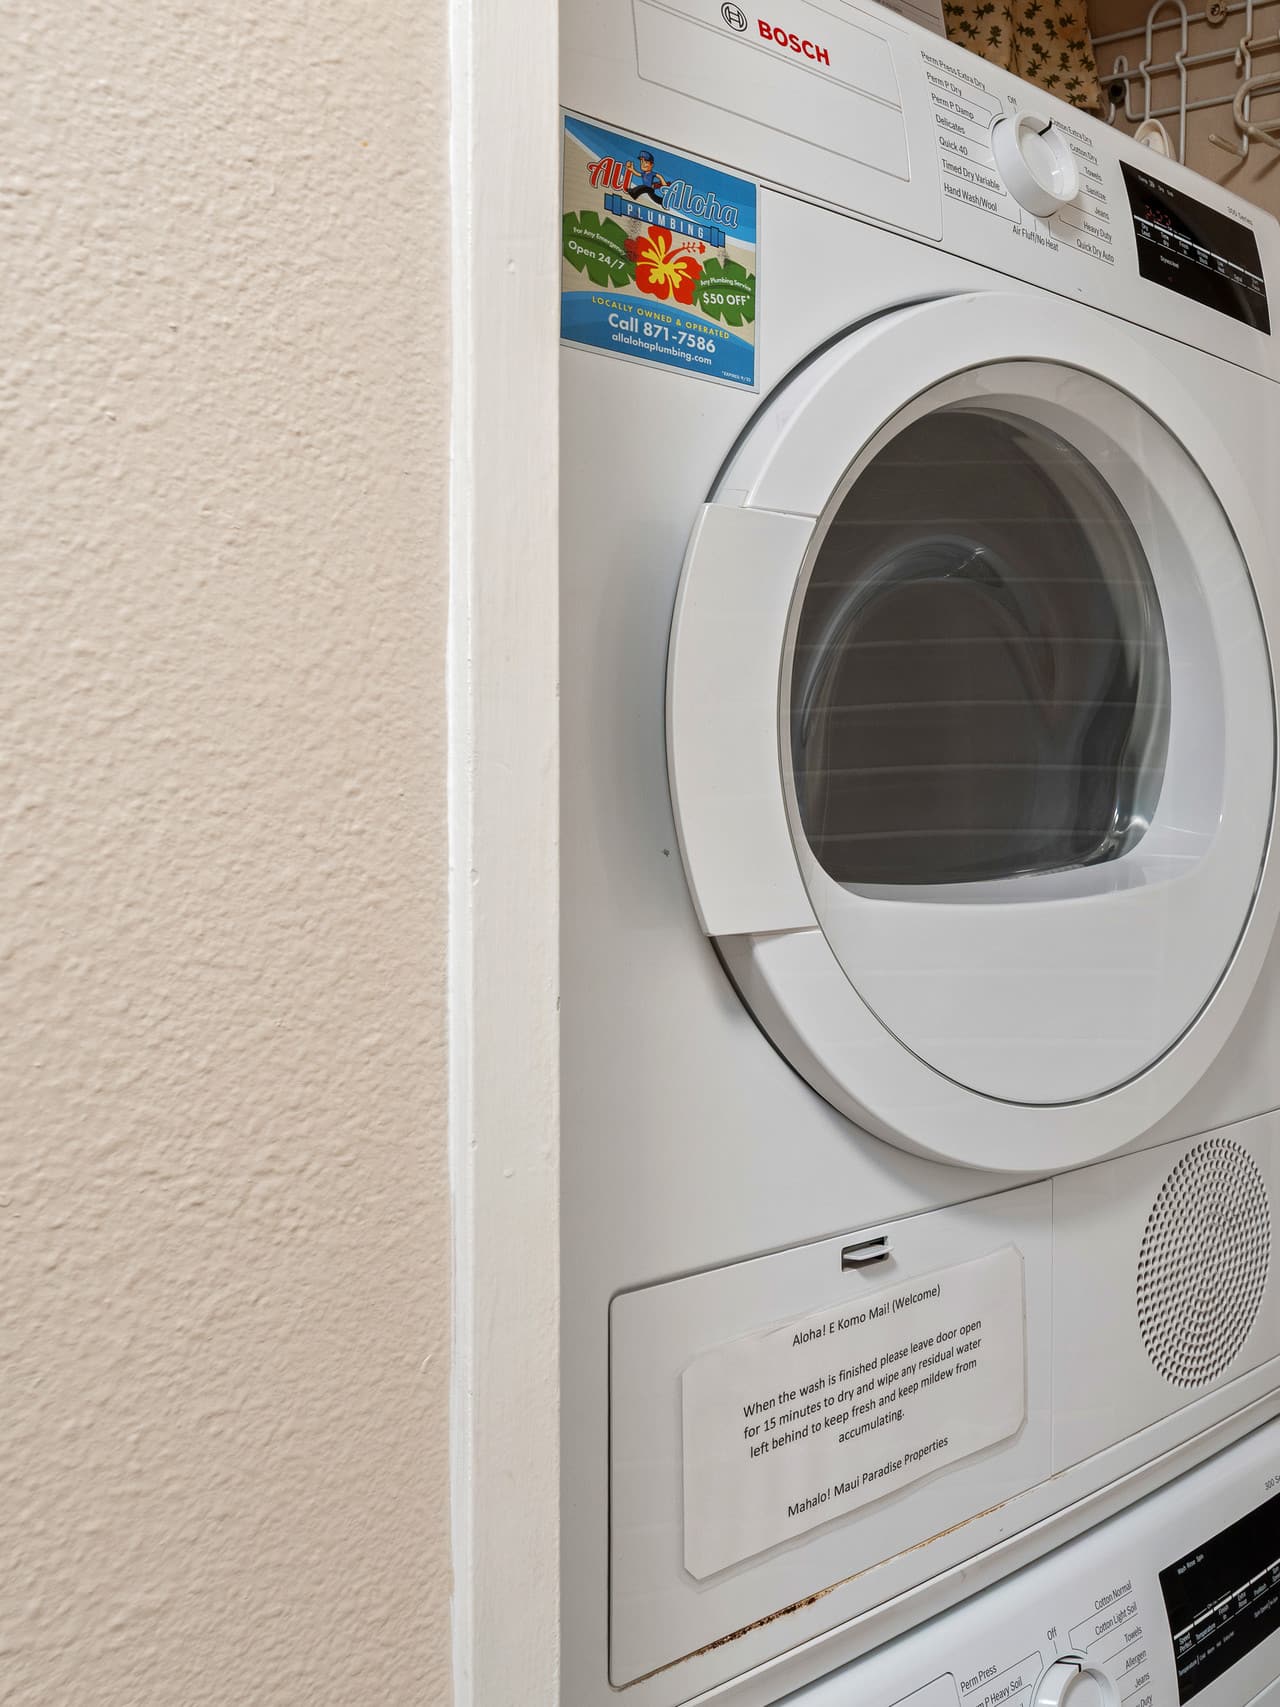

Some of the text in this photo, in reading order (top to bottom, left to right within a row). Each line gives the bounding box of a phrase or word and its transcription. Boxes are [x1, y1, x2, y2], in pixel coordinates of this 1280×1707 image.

[757, 19, 830, 66] BOSCH
[920, 50, 985, 91] Perm Press Extra Dry
[926, 71, 962, 96] Perm P Dry
[931, 92, 974, 120] Perm P Damp
[1007, 95, 1017, 105] Off
[935, 113, 965, 134] Delicates
[939, 136, 968, 155] Quick 40
[1069, 143, 1098, 165] Cotton Dry
[941, 158, 1000, 190] Timed Dry Variable
[1083, 166, 1102, 181] Towels
[587, 156, 738, 228] All Aloha
[944, 182, 998, 212] Hand Wash/Wool
[627, 204, 704, 239] PLUMBING
[1094, 206, 1110, 220] Jeans
[573, 227, 627, 256] For Any Emergency
[1012, 224, 1059, 252] Air Fluff/No Heat
[1083, 220, 1112, 242] Heavy Duty
[568, 240, 625, 270] Open 24/7
[1076, 238, 1115, 263] Quick Dry Auto
[703, 292, 724, 305] $50
[709, 277, 734, 286] Plumbing
[733, 279, 752, 292] Service
[592, 295, 730, 339] LOCALLY OWNED & OPERATED
[608, 313, 716, 353] Call 871-7586
[611, 332, 713, 365] allalohaplumbing.com
[792, 1283, 941, 1347] Aloha! E Komo Mai! (Welcome)
[743, 1320, 982, 1418] When the wash is finished please leave door open
[743, 1337, 982, 1439] for 15 minutes to dry and wipe any residual water
[750, 1358, 977, 1459] left behind to keep fresh and keep mildew from
[838, 1408, 905, 1443] accumulating.
[787, 1436, 949, 1517] Mahalo! Maui Paradise Properties
[1264, 1478, 1275, 1491] 300
[1094, 1579, 1132, 1610] Cotton Normal
[1046, 1625, 1058, 1641] Off
[1094, 1601, 1138, 1636] Cotton Light Soil
[1123, 1625, 1143, 1643] Towels
[1125, 1649, 1147, 1670] Allergen
[960, 1664, 998, 1693] Perm Press
[984, 1676, 1023, 1707] P Heavy Soil
[1134, 1672, 1151, 1689] Jeans
